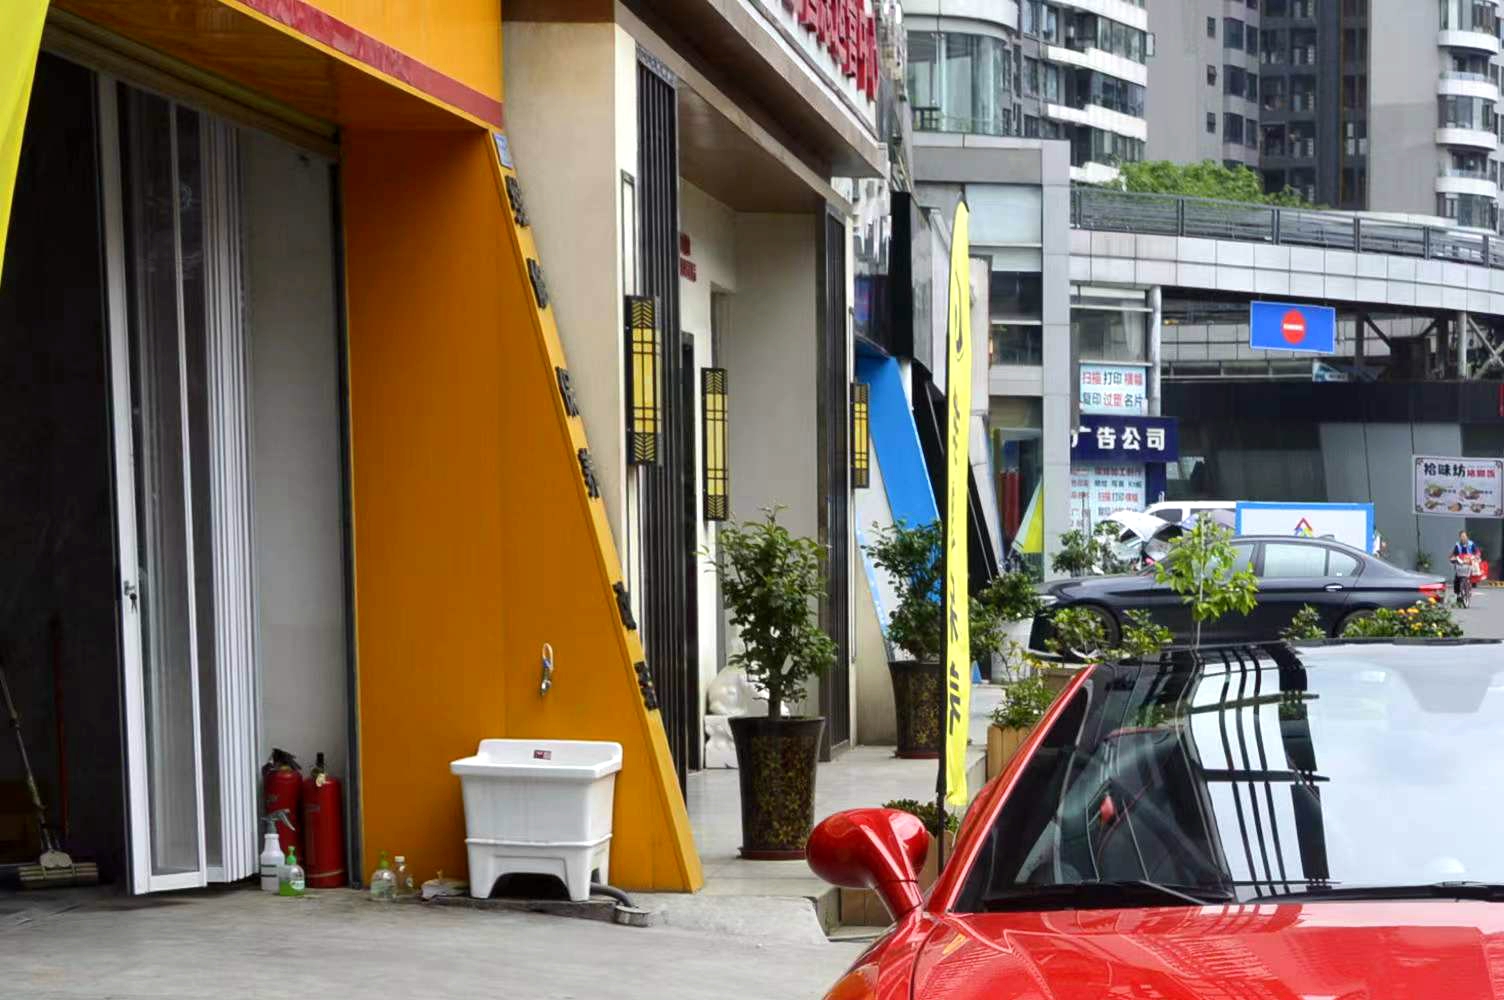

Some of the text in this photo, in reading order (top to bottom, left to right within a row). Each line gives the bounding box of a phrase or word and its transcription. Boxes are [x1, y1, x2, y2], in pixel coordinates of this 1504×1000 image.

[1104, 372, 1123, 385] 打印
[1083, 392, 1102, 406] 复印
[1125, 394, 1143, 407] 名片
[1071, 425, 1165, 451] 广告公司
